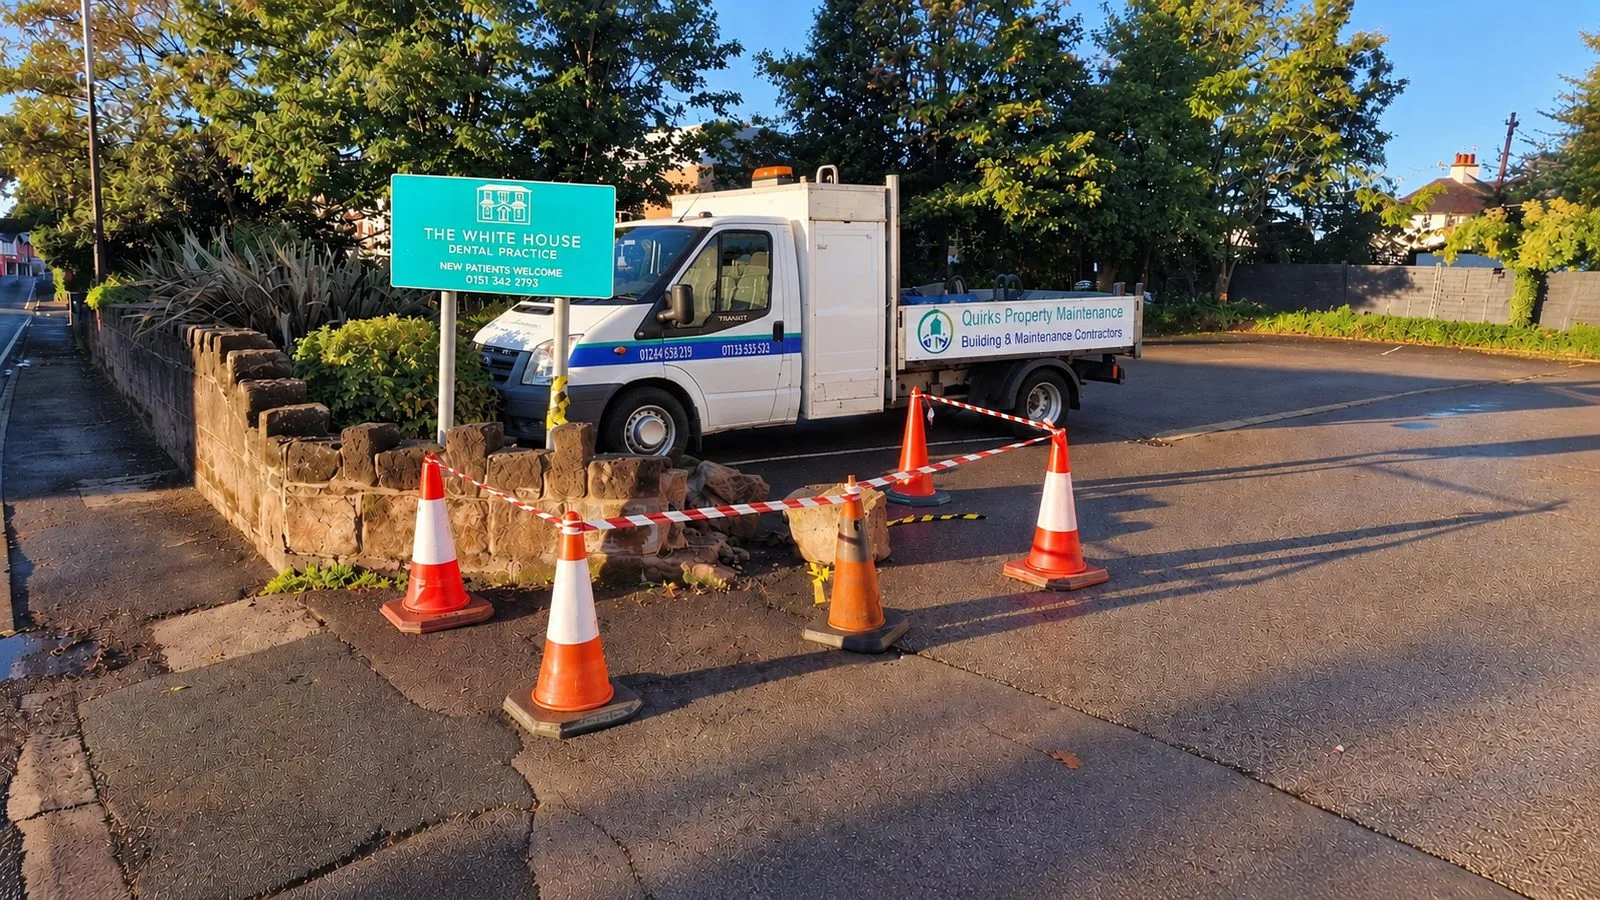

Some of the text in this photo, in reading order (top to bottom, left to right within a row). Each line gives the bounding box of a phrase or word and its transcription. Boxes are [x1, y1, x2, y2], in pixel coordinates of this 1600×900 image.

[424, 227, 582, 249] THE WHITE HOUSE
[448, 244, 557, 260] DENTAL PRACTICE
[440, 262, 563, 278] NEW PATIENTS WELCOME
[465, 275, 539, 288] 0151 342 2793
[961, 305, 1124, 327] Quirks Property Maintenance
[961, 334, 1002, 349] Building
[1004, 333, 1012, 346] &
[1014, 330, 1073, 345] Maintenance
[1074, 327, 1123, 341] Contractors
[679, 345, 693, 359] 219
